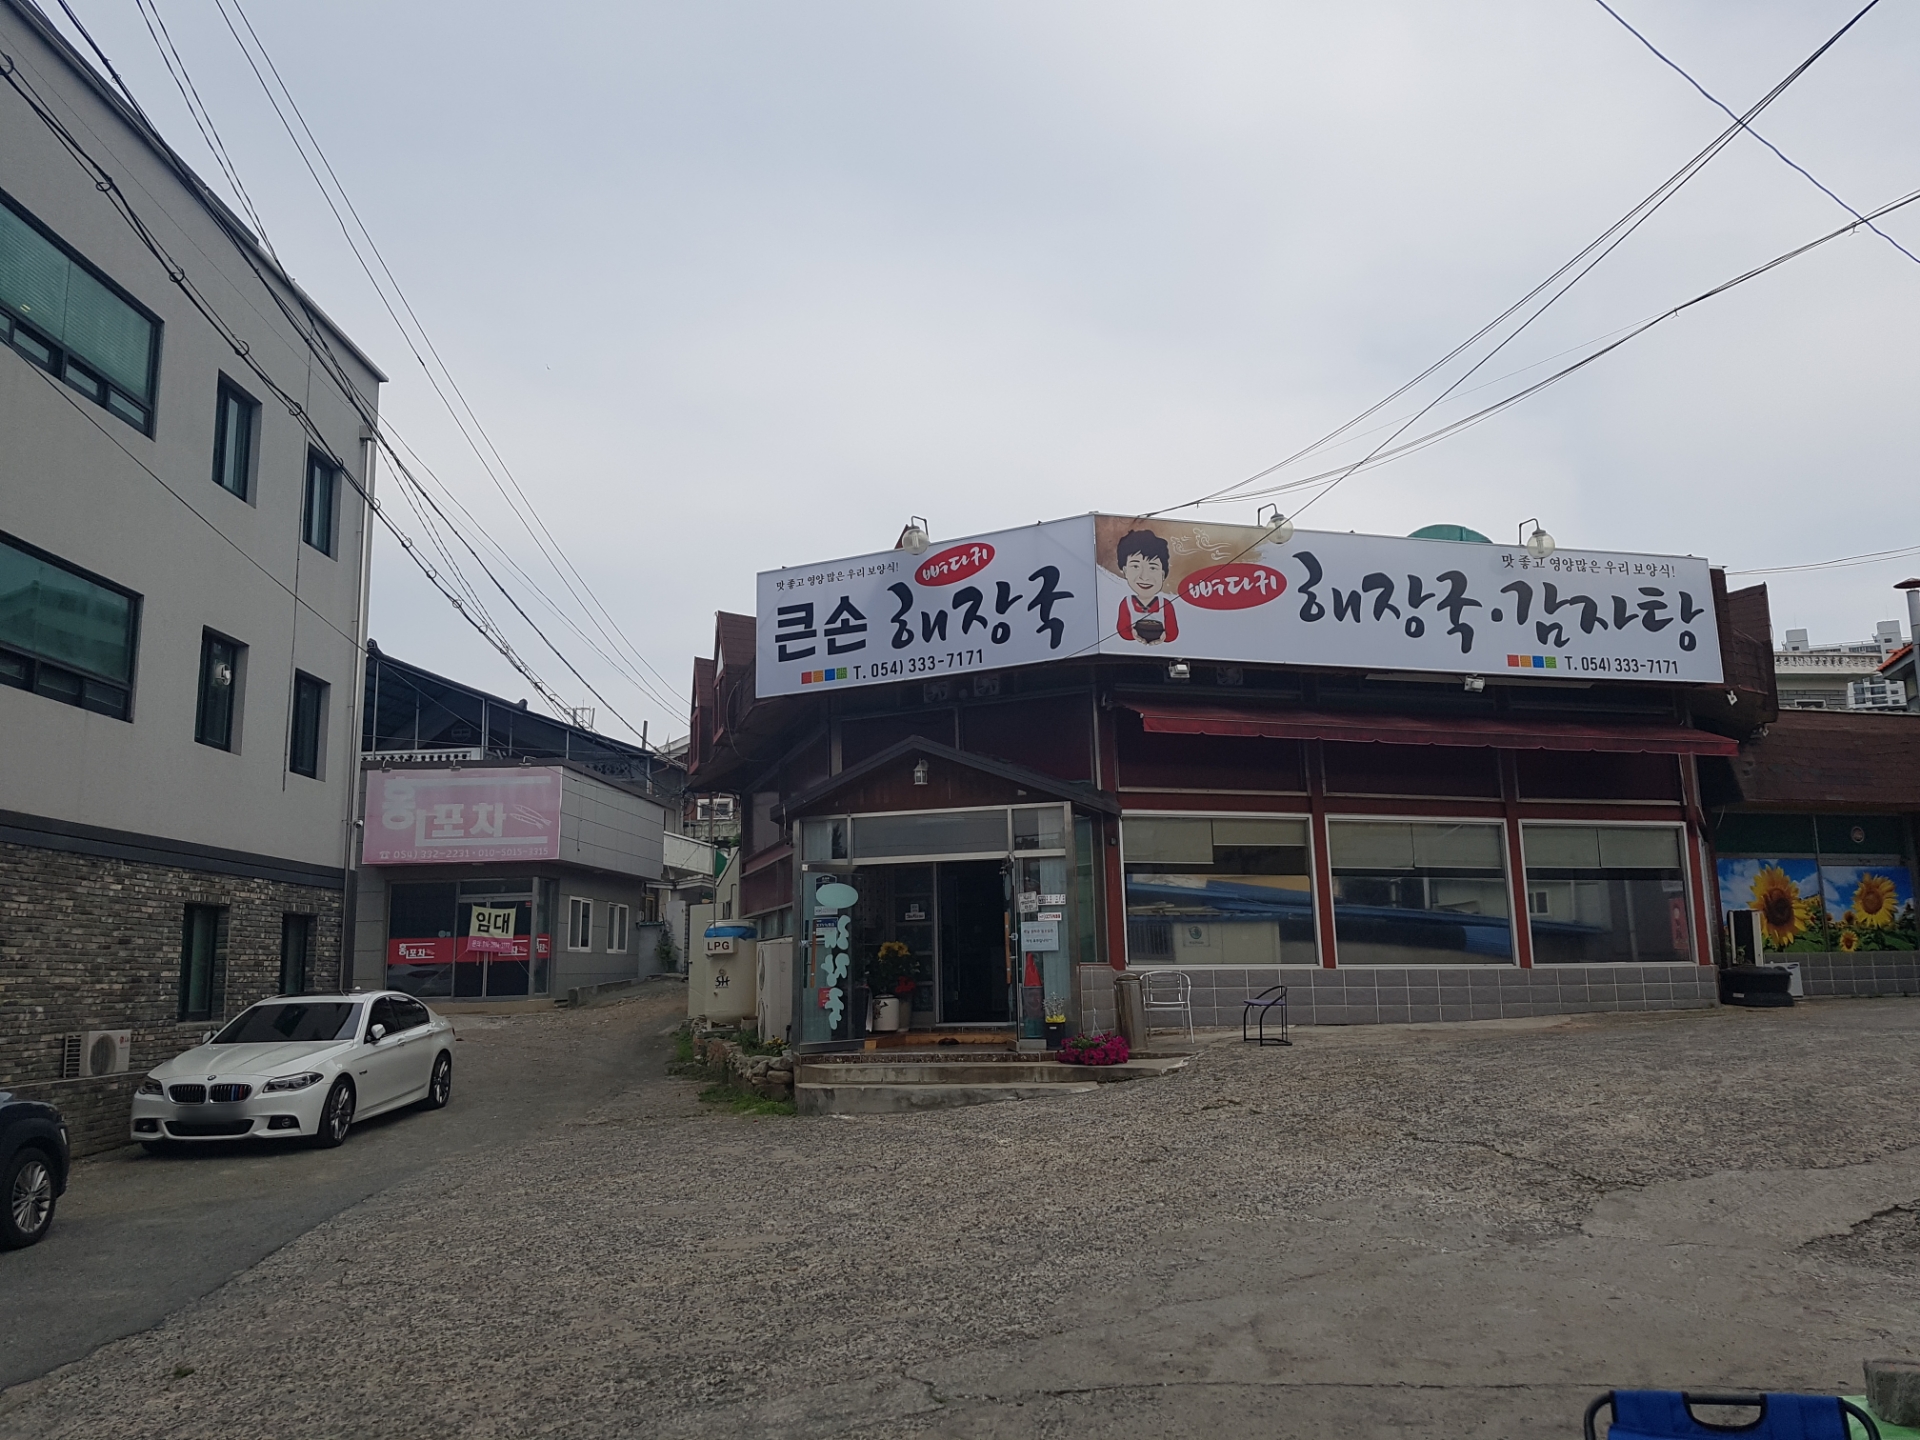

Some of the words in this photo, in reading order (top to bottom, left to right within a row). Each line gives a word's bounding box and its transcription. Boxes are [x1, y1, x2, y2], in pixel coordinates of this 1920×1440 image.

[775, 579, 785, 592] 맛
[786, 577, 805, 590] 좋고
[807, 573, 825, 587] 영양
[826, 571, 846, 583] 많은
[846, 566, 866, 580] 우리
[867, 561, 899, 576] 보양식!
[922, 546, 989, 581] 뼈다귀
[1501, 553, 1515, 569] 맛
[1518, 554, 1546, 570] 좋고
[1604, 560, 1630, 576] 우리
[1633, 563, 1676, 578] 보양식!
[1188, 569, 1278, 599] 뼈다귀
[774, 595, 868, 663] 큰손
[886, 564, 1076, 651] 해장국
[852, 664, 867, 681] T.
[908, 650, 984, 674] 333-7171
[1564, 655, 1579, 671] T.
[1614, 657, 1679, 675] 333-7171
[475, 911, 511, 935] 임대
[706, 940, 731, 951] LPG
